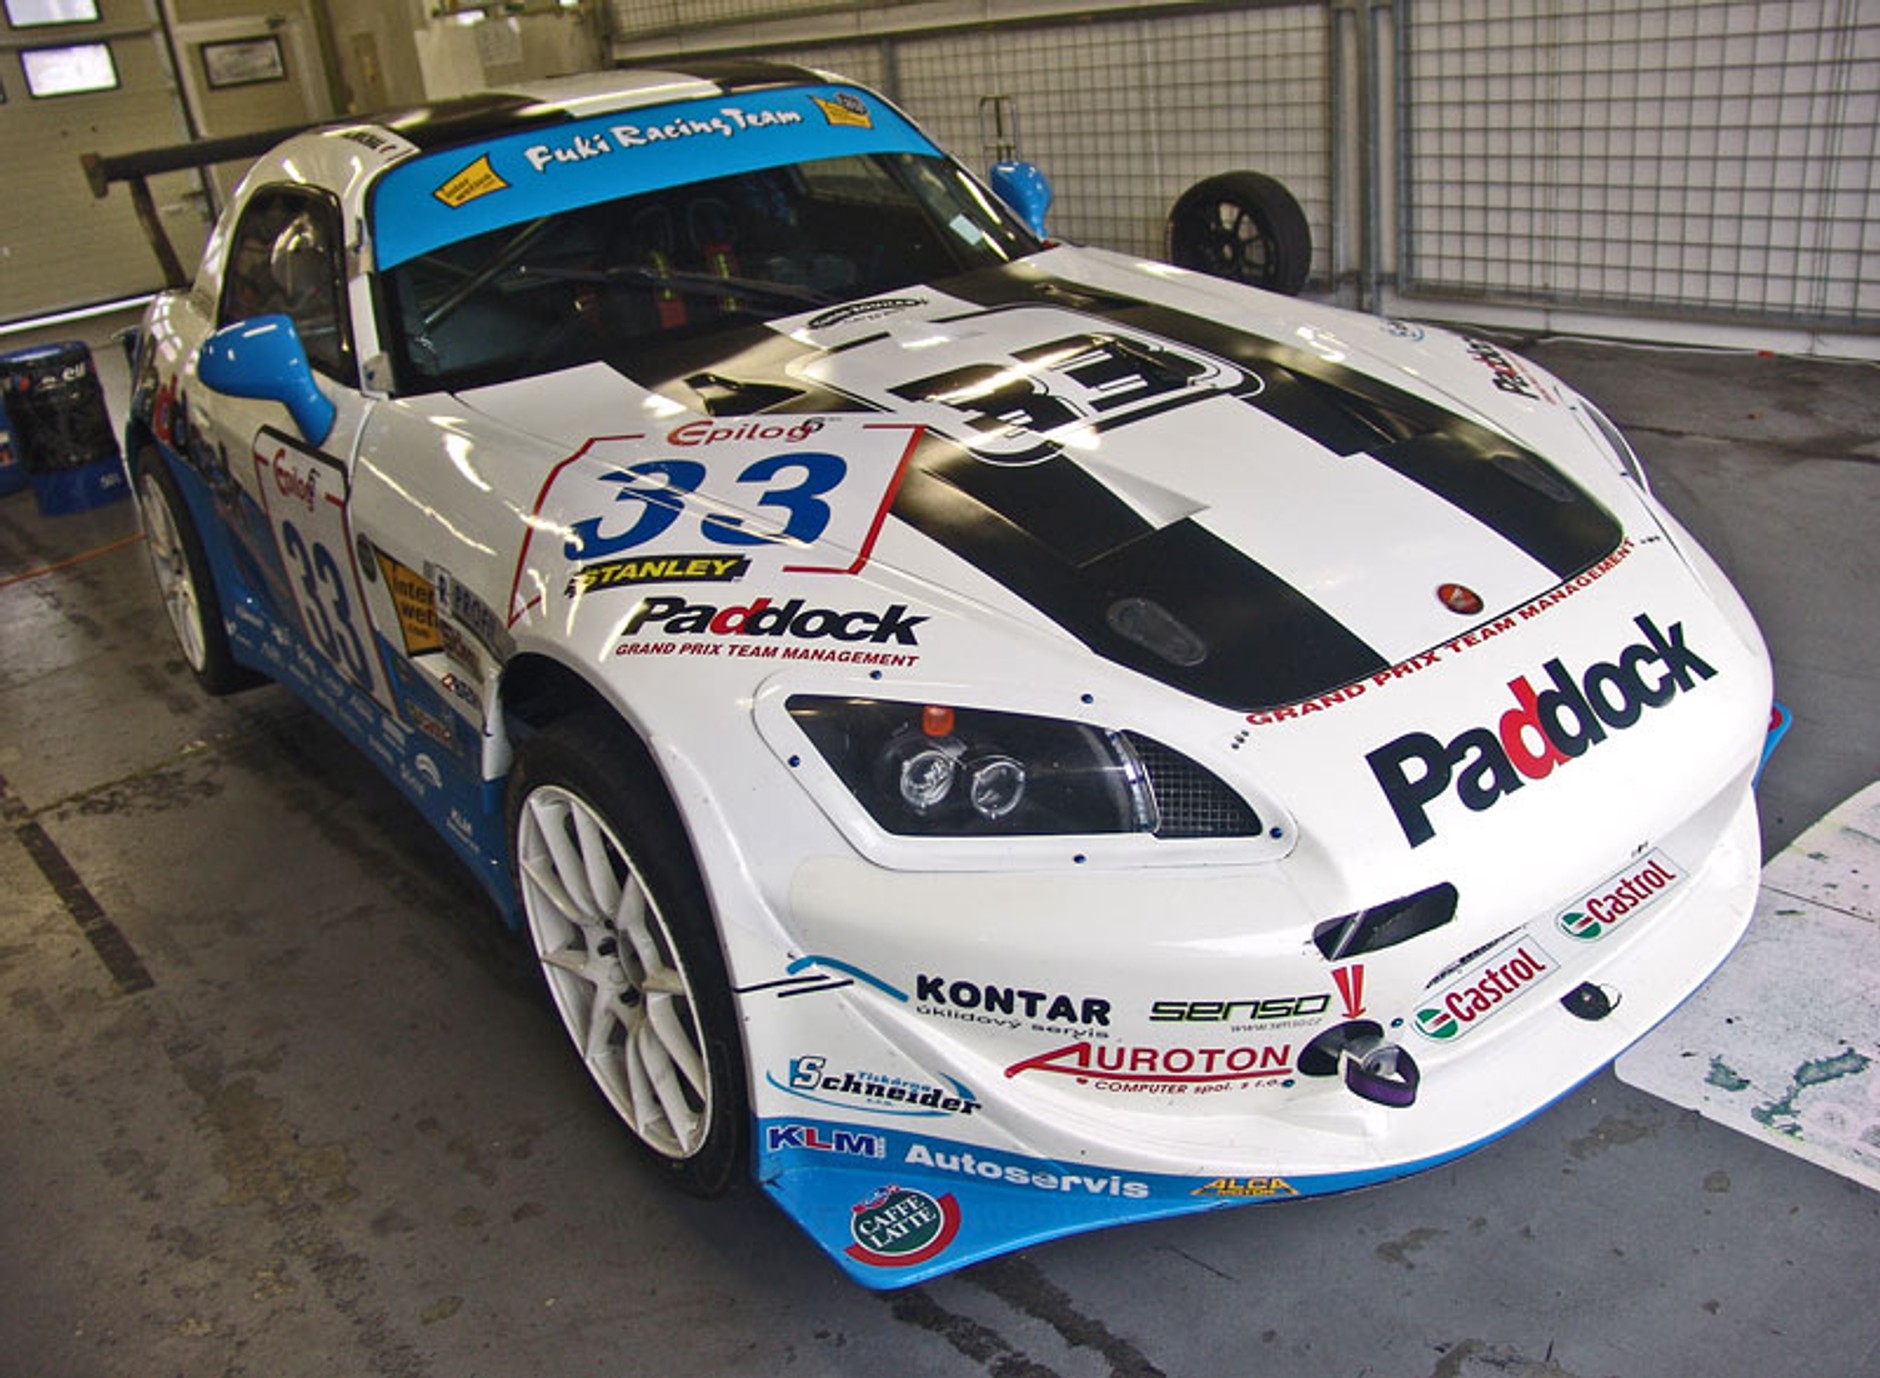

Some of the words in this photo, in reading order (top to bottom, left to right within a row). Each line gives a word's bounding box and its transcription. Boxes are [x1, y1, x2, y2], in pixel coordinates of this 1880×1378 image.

[525, 134, 612, 172] Fuki
[609, 117, 733, 149] Racing
[667, 421, 812, 447] Epilog
[564, 452, 847, 560] 33
[582, 559, 739, 586] STANLEY
[282, 520, 374, 692] 33
[621, 597, 932, 646] Paddock
[1246, 683, 1367, 728] GRAND
[1371, 650, 1443, 688] PRIX
[1443, 616, 1519, 655] TEAM
[1517, 536, 1637, 621] MANAGEMENT
[616, 643, 677, 657] GRAND
[679, 643, 723, 657] PRIX
[727, 645, 779, 659] TEAM
[783, 647, 920, 668] MANAGEMENT
[1364, 613, 1719, 850] Paddock
[1587, 858, 1678, 925] Castrol
[916, 973, 1111, 1027] KONTAR
[1149, 993, 1332, 1022] senso
[1446, 948, 1547, 1023] Castrol
[790, 1054, 982, 1115] Schneider
[1004, 1041, 1292, 1080] AUROTON
[1095, 1080, 1189, 1095] COMPUTER
[766, 1123, 877, 1159] KLM
[904, 1143, 1150, 1199] Autoservis
[869, 1206, 937, 1249] LATTE
